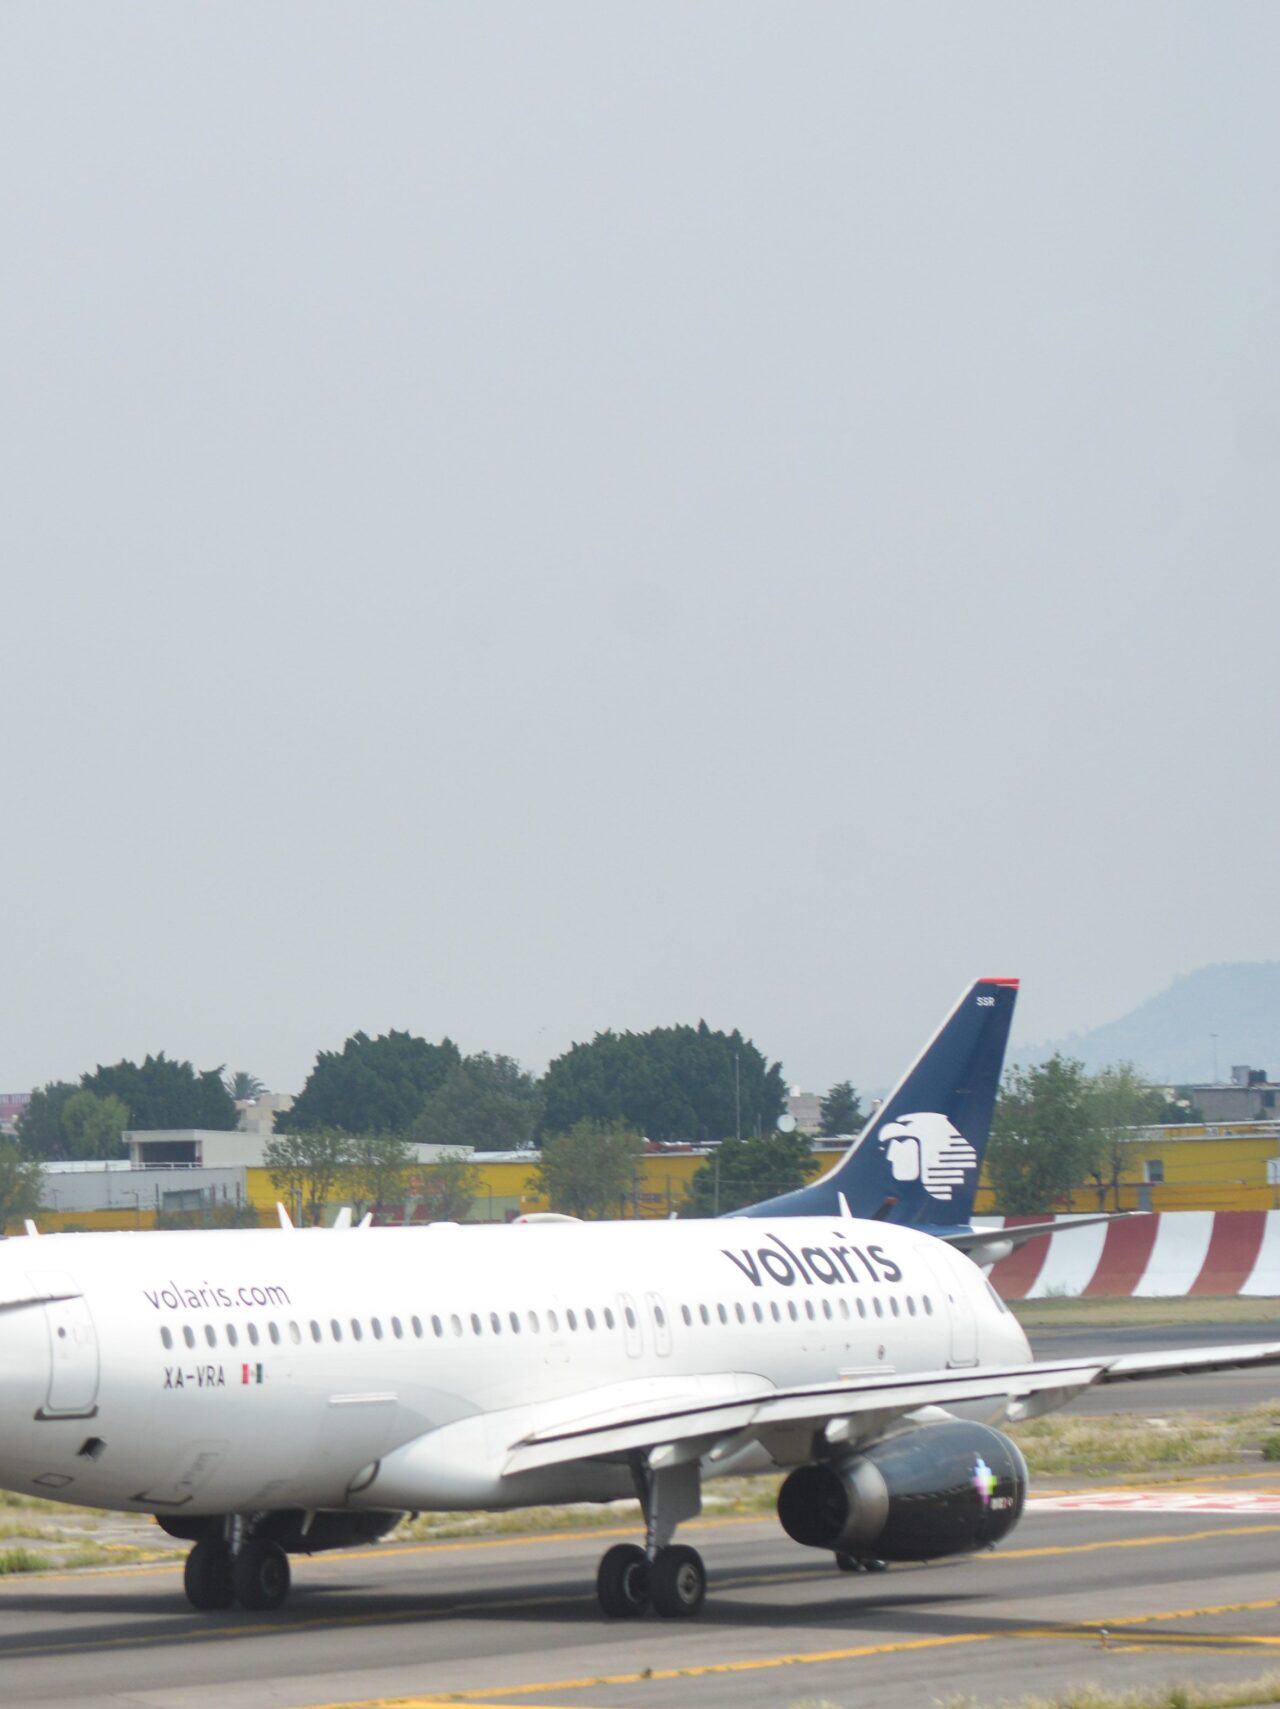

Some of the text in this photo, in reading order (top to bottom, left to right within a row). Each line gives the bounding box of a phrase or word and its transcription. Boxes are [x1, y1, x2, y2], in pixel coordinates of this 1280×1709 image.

[976, 996, 995, 1007] SSR
[720, 1231, 902, 1287] volaris
[143, 1279, 291, 1310] volaris.com
[163, 1364, 225, 1389] XA-VRA
